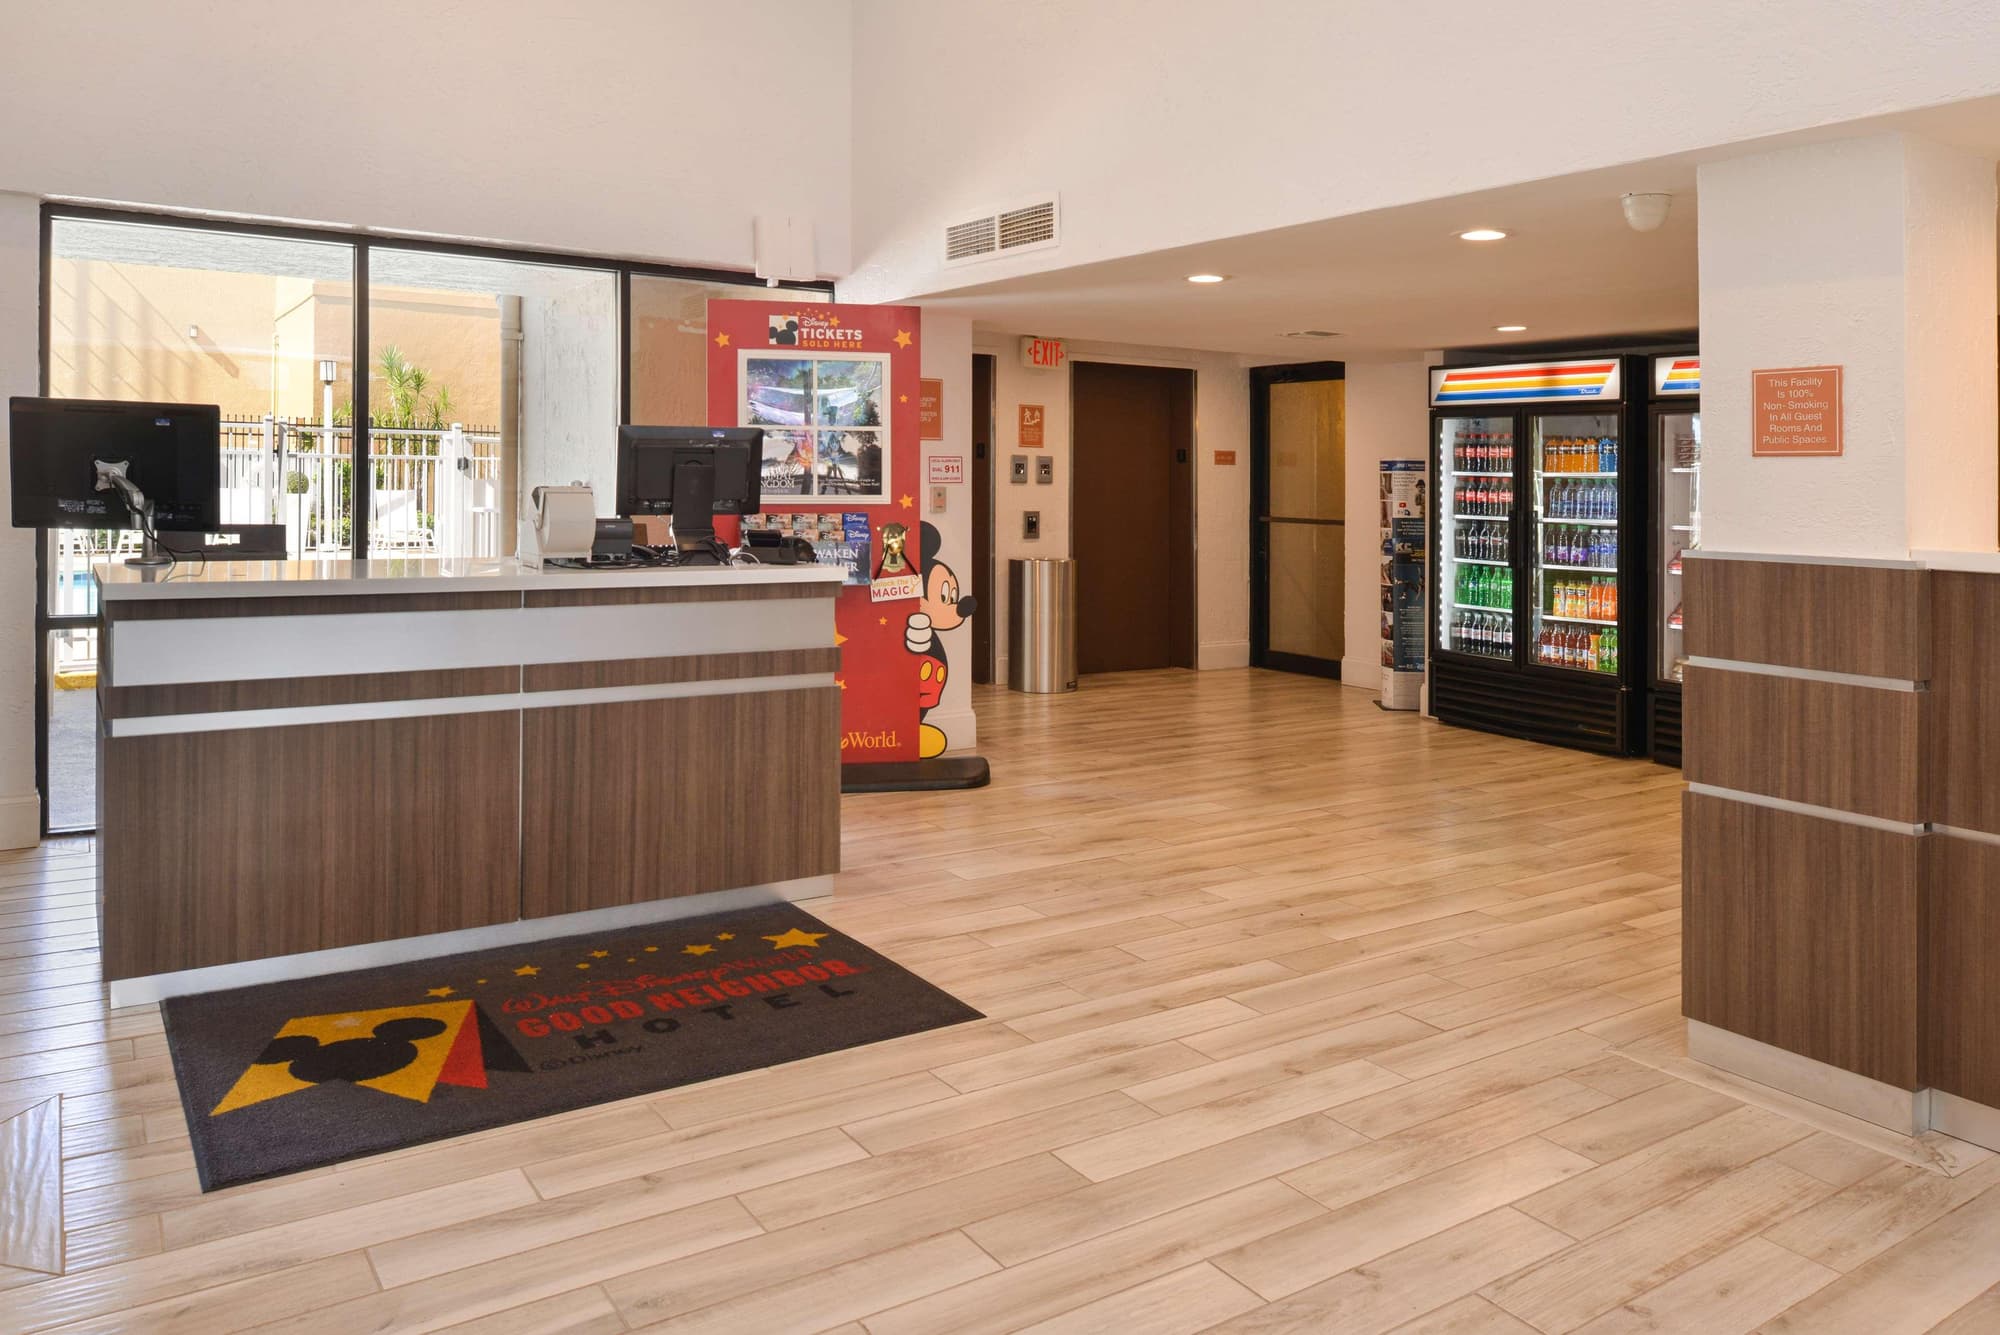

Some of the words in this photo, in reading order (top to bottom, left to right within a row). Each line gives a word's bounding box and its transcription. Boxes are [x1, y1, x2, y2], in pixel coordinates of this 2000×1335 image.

[800, 316, 829, 329] Disney
[801, 328, 863, 341] TICKETS
[802, 340, 830, 348] SOLD
[834, 341, 863, 349] HERE
[1033, 339, 1061, 367] EXIT
[1768, 378, 1788, 387] This
[1791, 376, 1823, 387] Facility
[1777, 390, 1786, 398] Is
[1789, 389, 1814, 397] 100%
[1769, 413, 1779, 421] In
[1780, 412, 1792, 421] All
[1795, 411, 1823, 421] Guest
[1770, 424, 1802, 433] Rooms
[1804, 423, 1823, 432] And
[1762, 435, 1790, 444] Public
[944, 464, 960, 474] 911
[845, 513, 867, 524] Disney
[848, 529, 870, 540] Disney
[813, 548, 859, 559] WAKEN
[872, 585, 910, 599] MAGIC
[848, 730, 897, 749] World
[516, 999, 645, 1038] GOOD
[646, 959, 857, 1012] NEIGHBOR
[573, 983, 857, 1050] HOTEL
